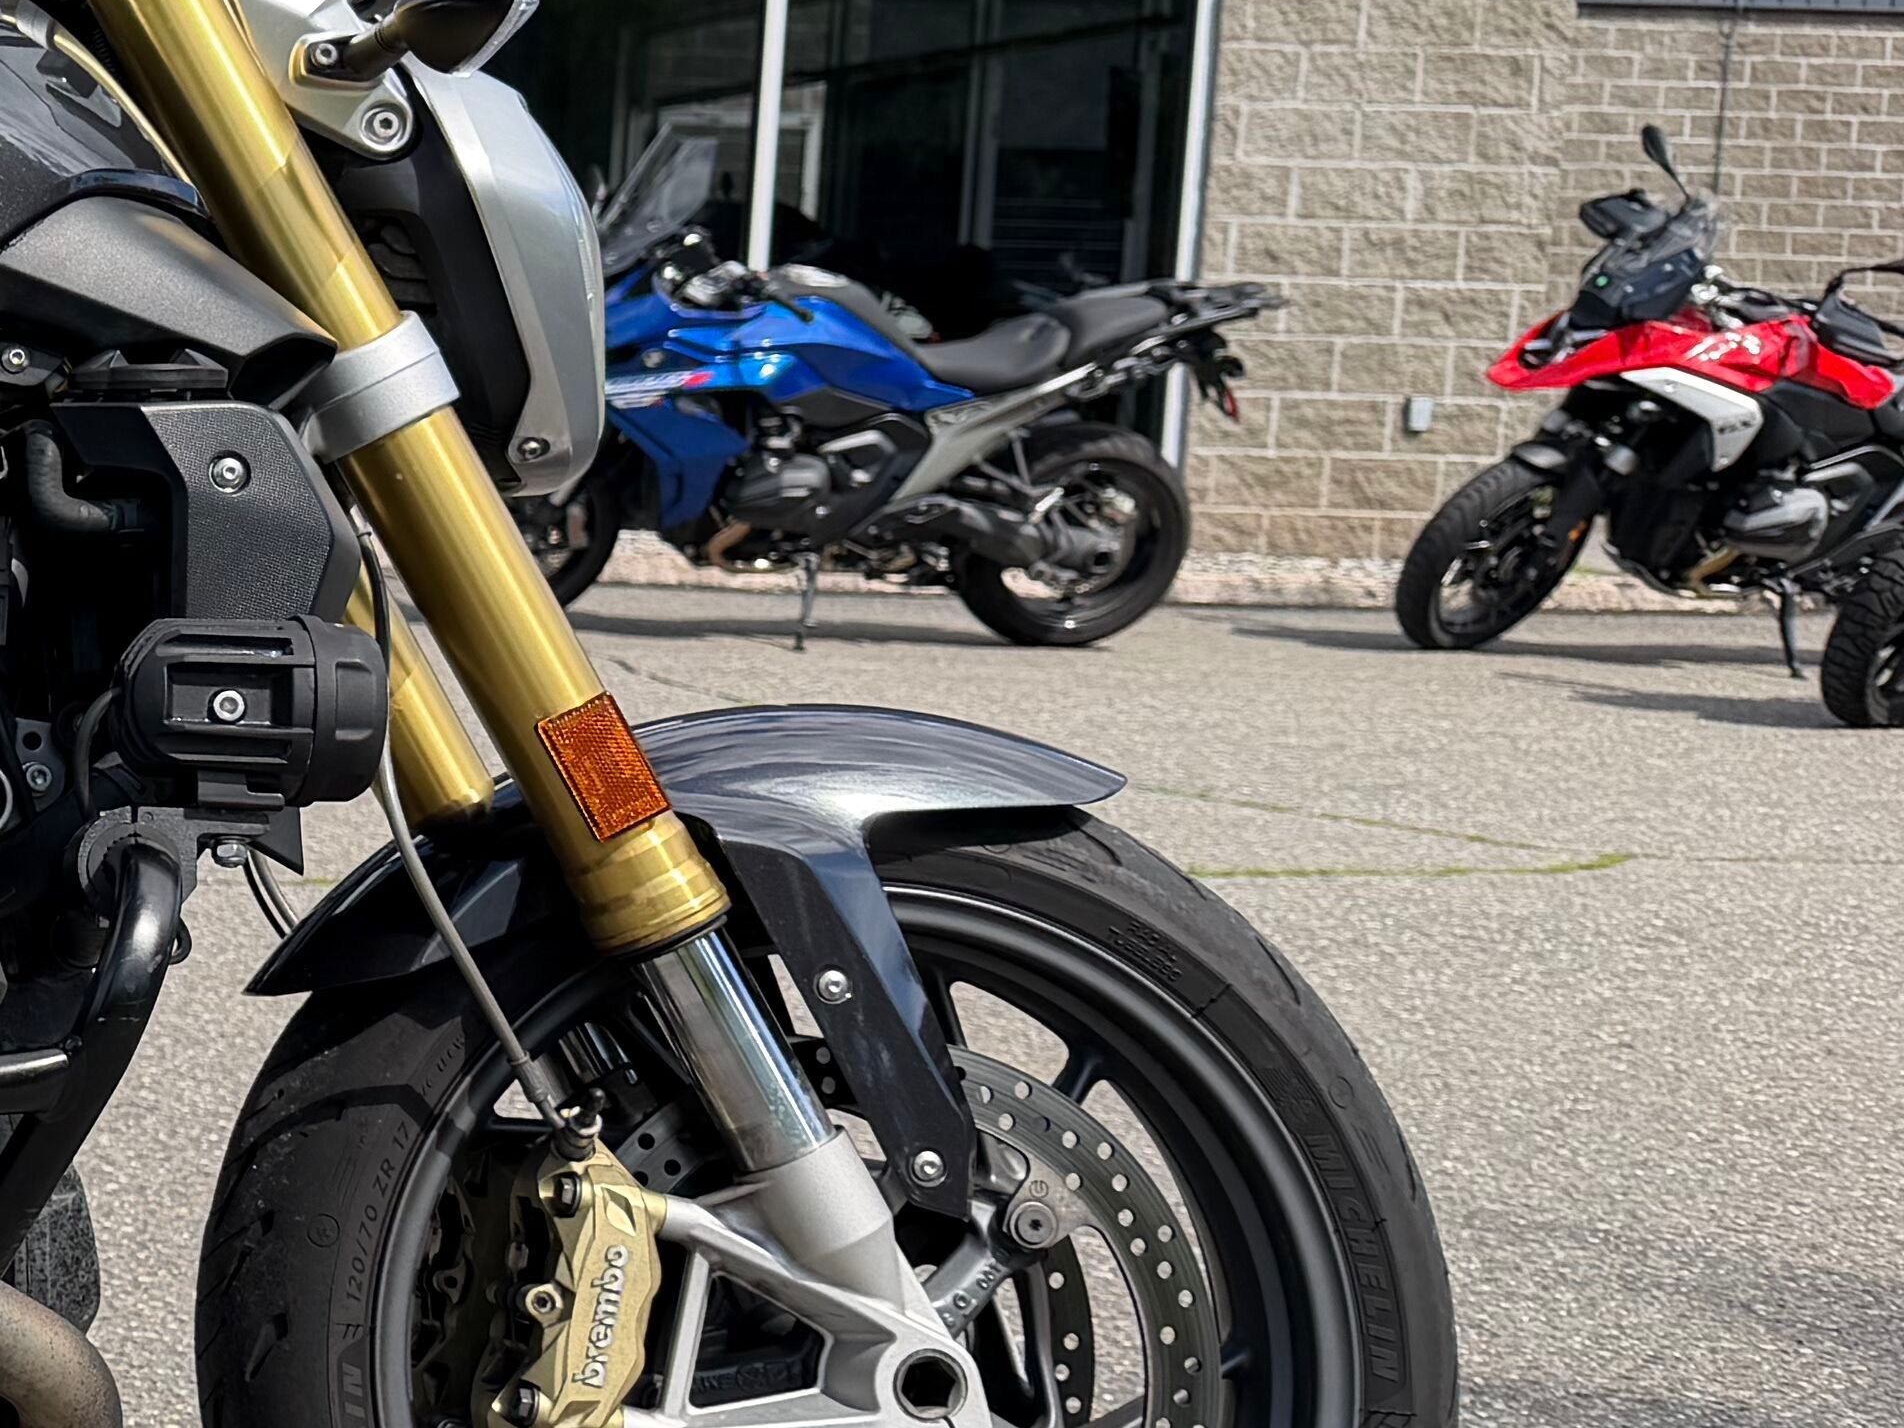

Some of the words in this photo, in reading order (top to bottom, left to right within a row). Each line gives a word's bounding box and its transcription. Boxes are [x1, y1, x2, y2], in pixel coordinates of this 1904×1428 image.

[345, 1203, 379, 1304] 120/70
[371, 1160, 397, 1200] ZR
[390, 1120, 414, 1157] 17
[1304, 1132, 1400, 1384] MICHELIN
[572, 1244, 630, 1389] brembo
